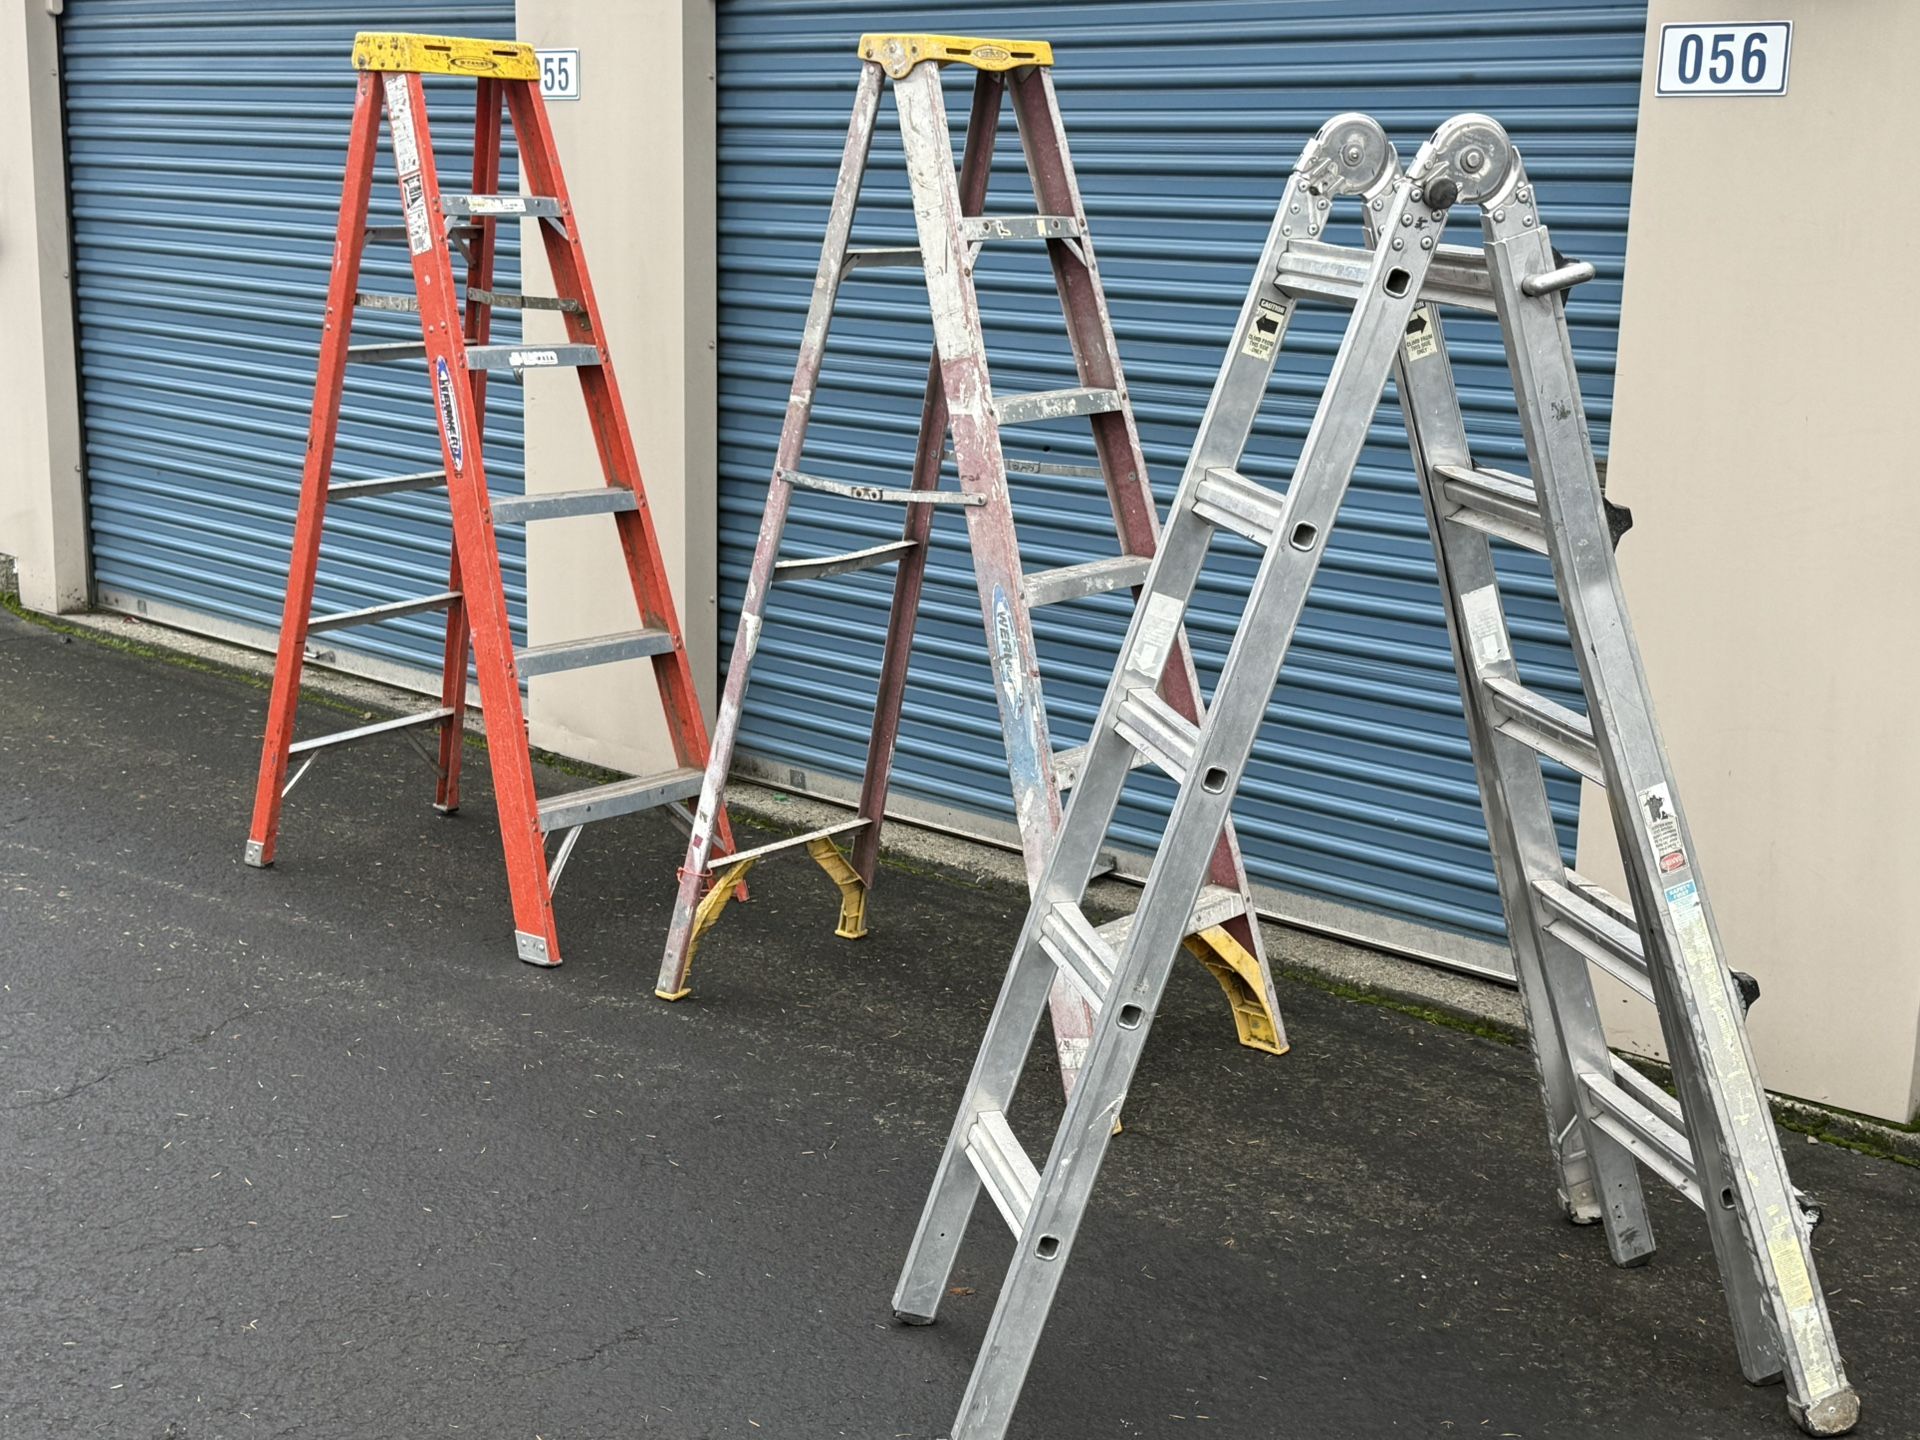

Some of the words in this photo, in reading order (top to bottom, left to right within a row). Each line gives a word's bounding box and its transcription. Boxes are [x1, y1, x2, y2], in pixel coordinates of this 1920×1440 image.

[1678, 32, 1768, 84] 056
[538, 57, 569, 91] 55
[1260, 299, 1285, 314] CAUTION
[1247, 333, 1261, 343] CLIMB
[1261, 338, 1274, 347] FROM
[1406, 338, 1420, 347] CLIMB
[1420, 333, 1433, 341] FROM
[1251, 347, 1262, 355] ONLY
[439, 380, 459, 446] WERNER
[1668, 883, 1690, 896] SAFETY
[1672, 889, 1689, 899] FIRST
